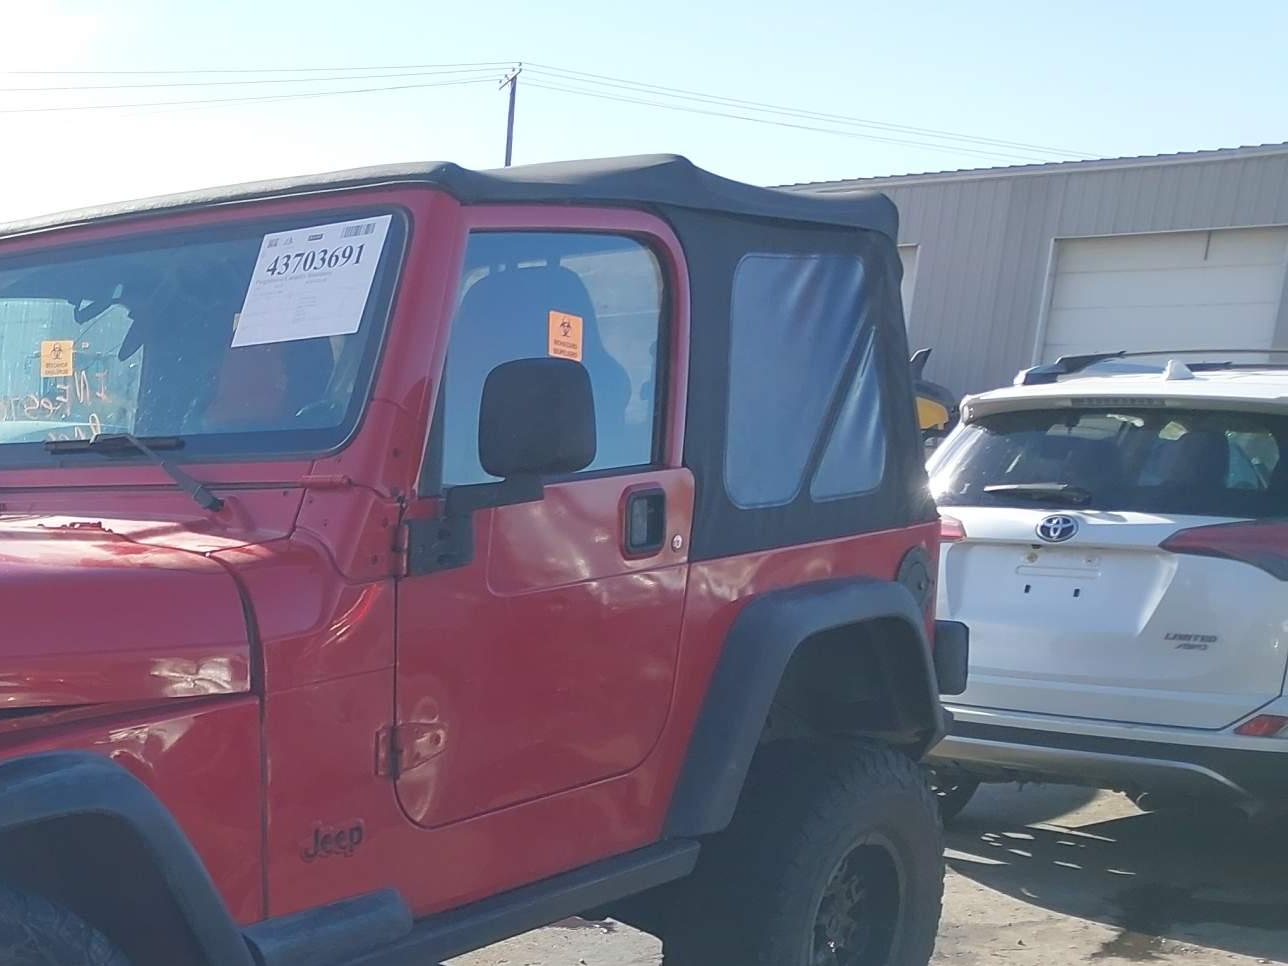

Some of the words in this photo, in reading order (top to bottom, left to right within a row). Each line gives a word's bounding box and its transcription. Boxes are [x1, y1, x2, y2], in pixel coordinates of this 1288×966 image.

[266, 243, 366, 277] 43703691
[1164, 632, 1218, 643] LIMITED
[302, 824, 364, 862] Jeep
